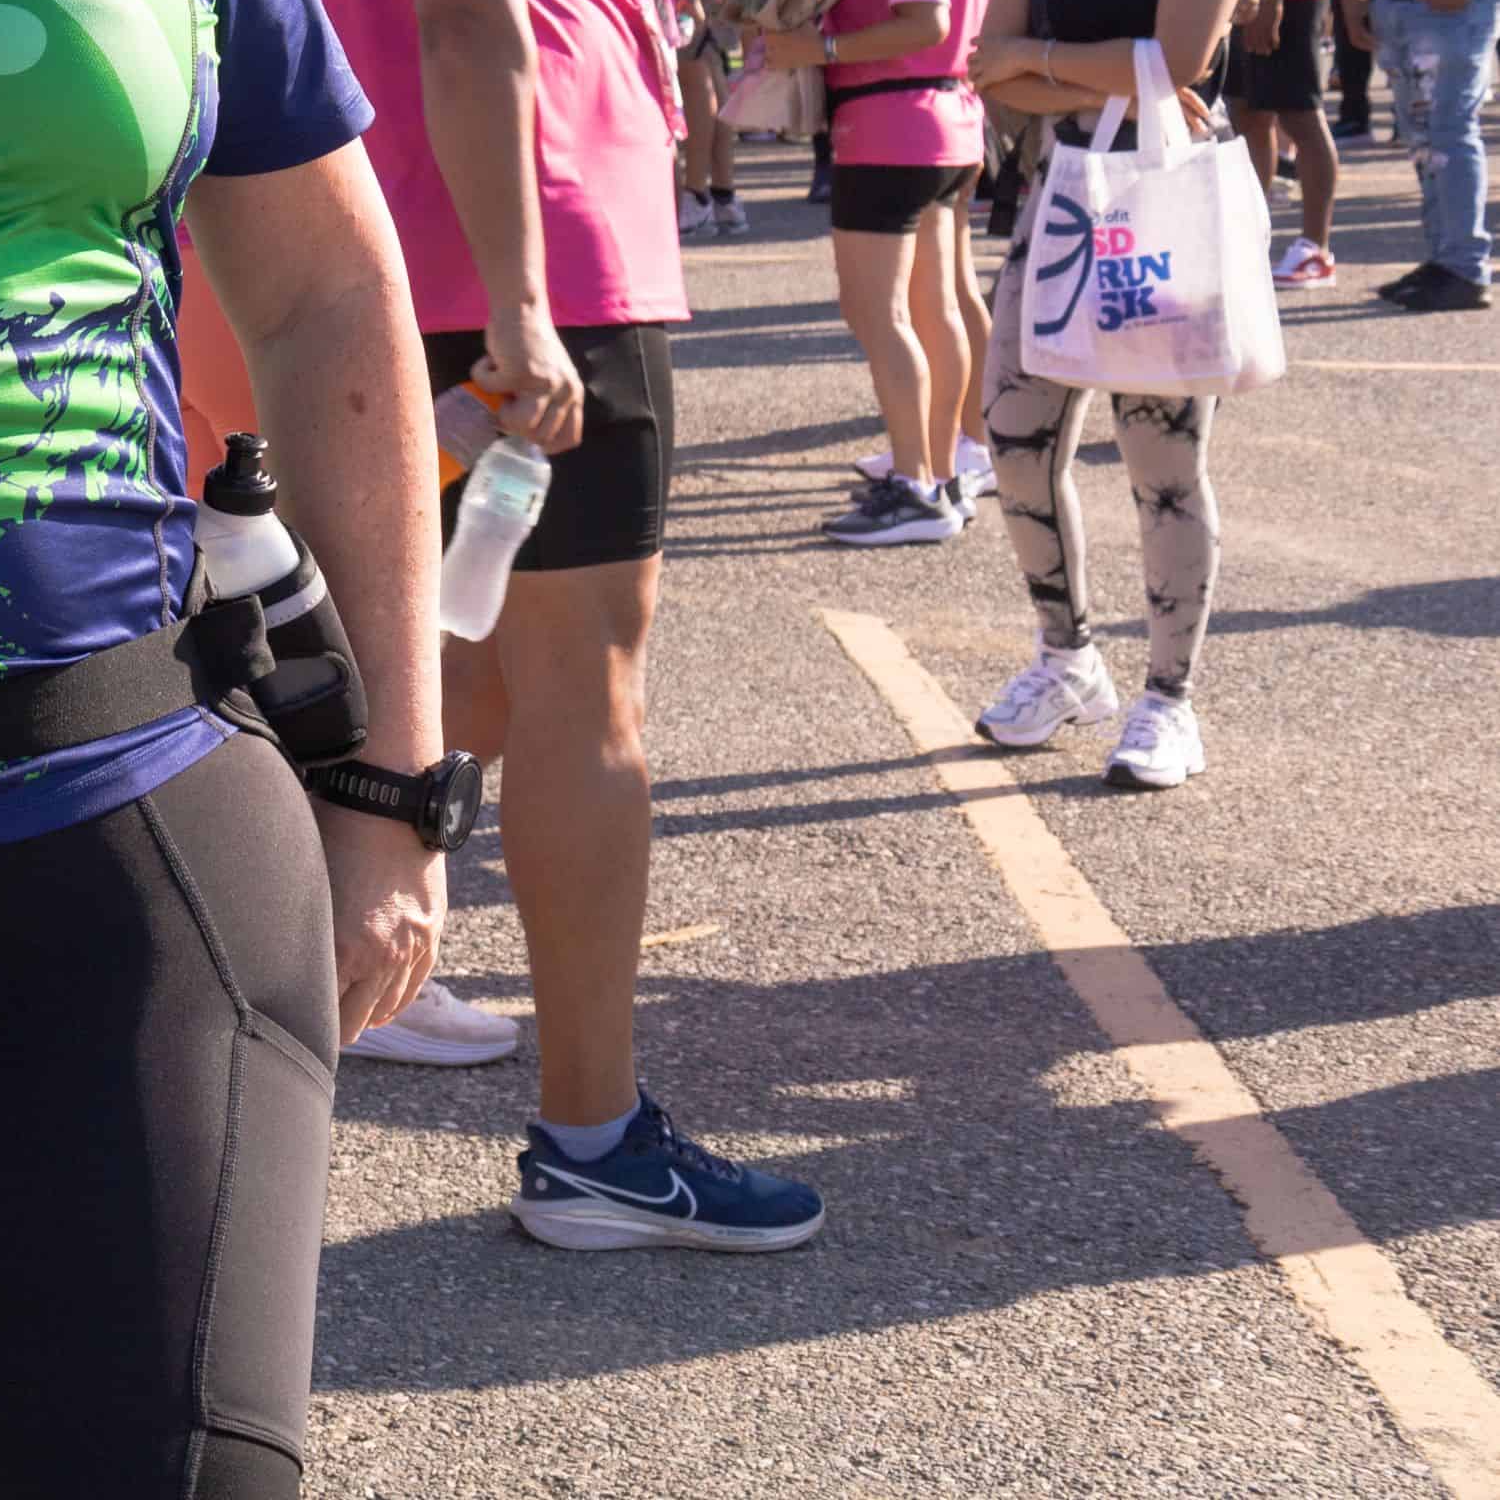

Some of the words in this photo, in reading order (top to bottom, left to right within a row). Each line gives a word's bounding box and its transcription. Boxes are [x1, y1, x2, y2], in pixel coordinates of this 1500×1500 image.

[1093, 227, 1137, 257] SD
[1096, 251, 1171, 289] RUN
[1096, 286, 1158, 331] 5K
